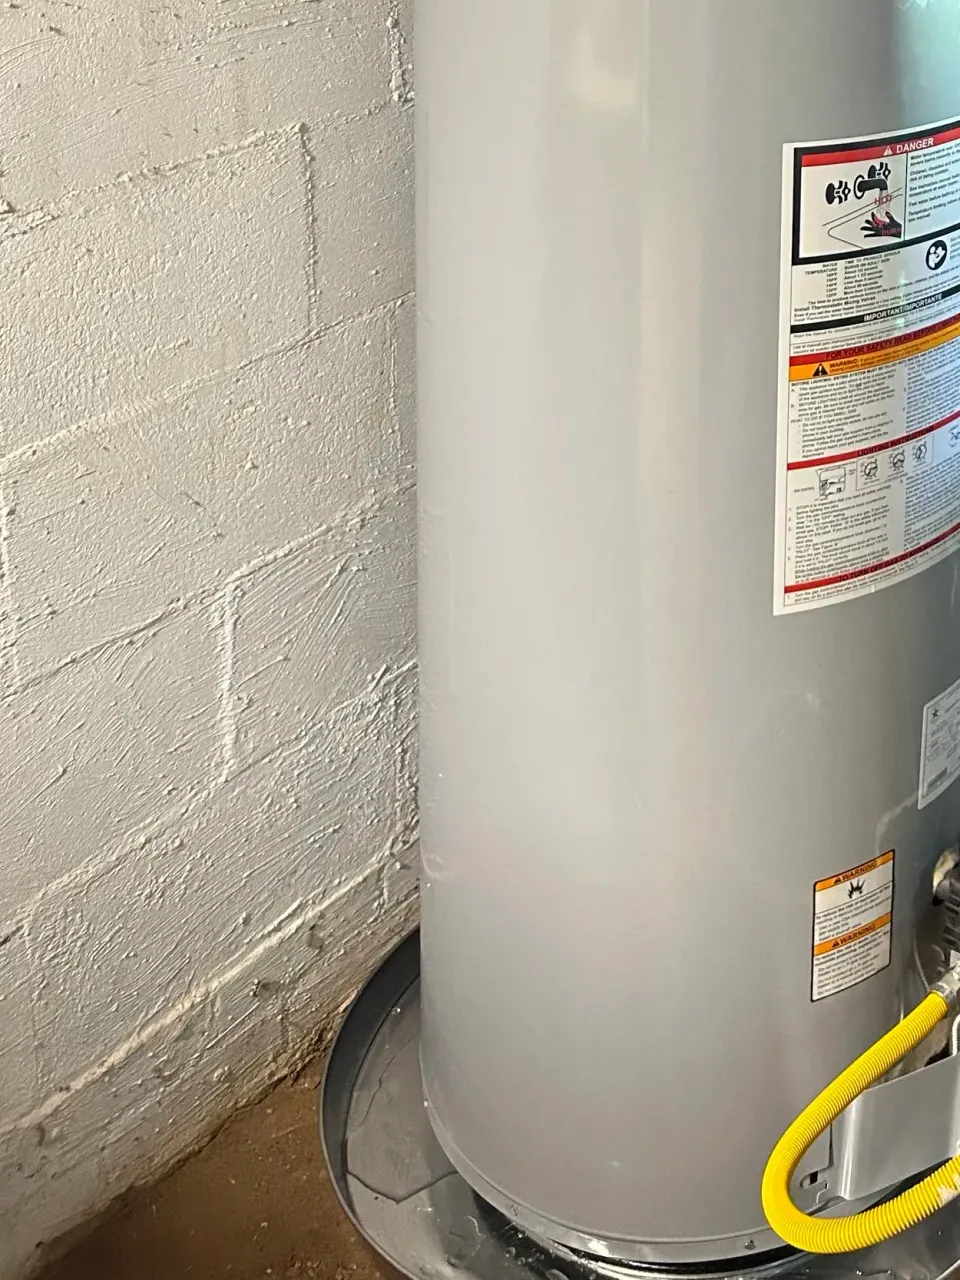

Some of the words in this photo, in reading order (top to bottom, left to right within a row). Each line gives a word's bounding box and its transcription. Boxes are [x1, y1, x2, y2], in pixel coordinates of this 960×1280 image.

[896, 138, 934, 154] DANGER
[864, 292, 943, 322] IMPORTANT/IMPORTANTE
[824, 349, 843, 360] FOR
[844, 346, 866, 357] YOUR
[866, 339, 894, 353] SAFETY
[857, 441, 890, 457] LIGHTING
[891, 425, 934, 447] INSTRUCTIONS
[842, 860, 878, 881] WARNING
[840, 923, 876, 944] WARNING
